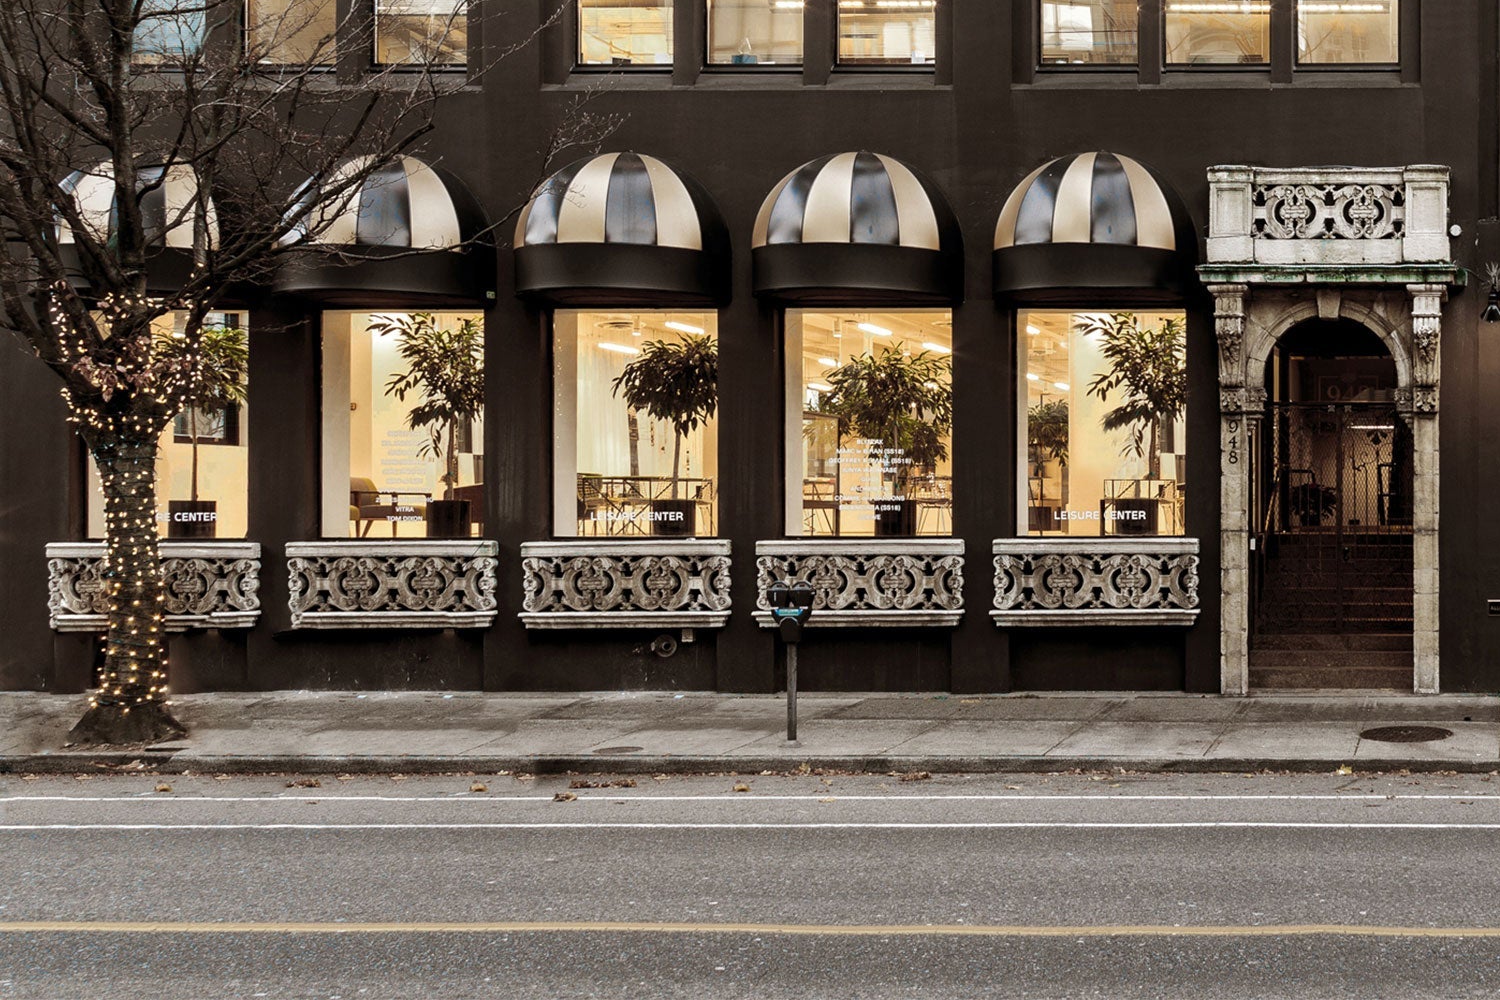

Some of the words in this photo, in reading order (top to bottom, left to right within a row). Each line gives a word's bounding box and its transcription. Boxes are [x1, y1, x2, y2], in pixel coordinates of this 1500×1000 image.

[1228, 420, 1238, 464] 948
[880, 504, 901, 512] (SS18)
[174, 512, 217, 522] CENTER
[590, 511, 636, 521] LEISURE
[640, 511, 684, 521] CENTER
[1054, 511, 1099, 520] LEISURE
[1103, 511, 1146, 520] CENTER
